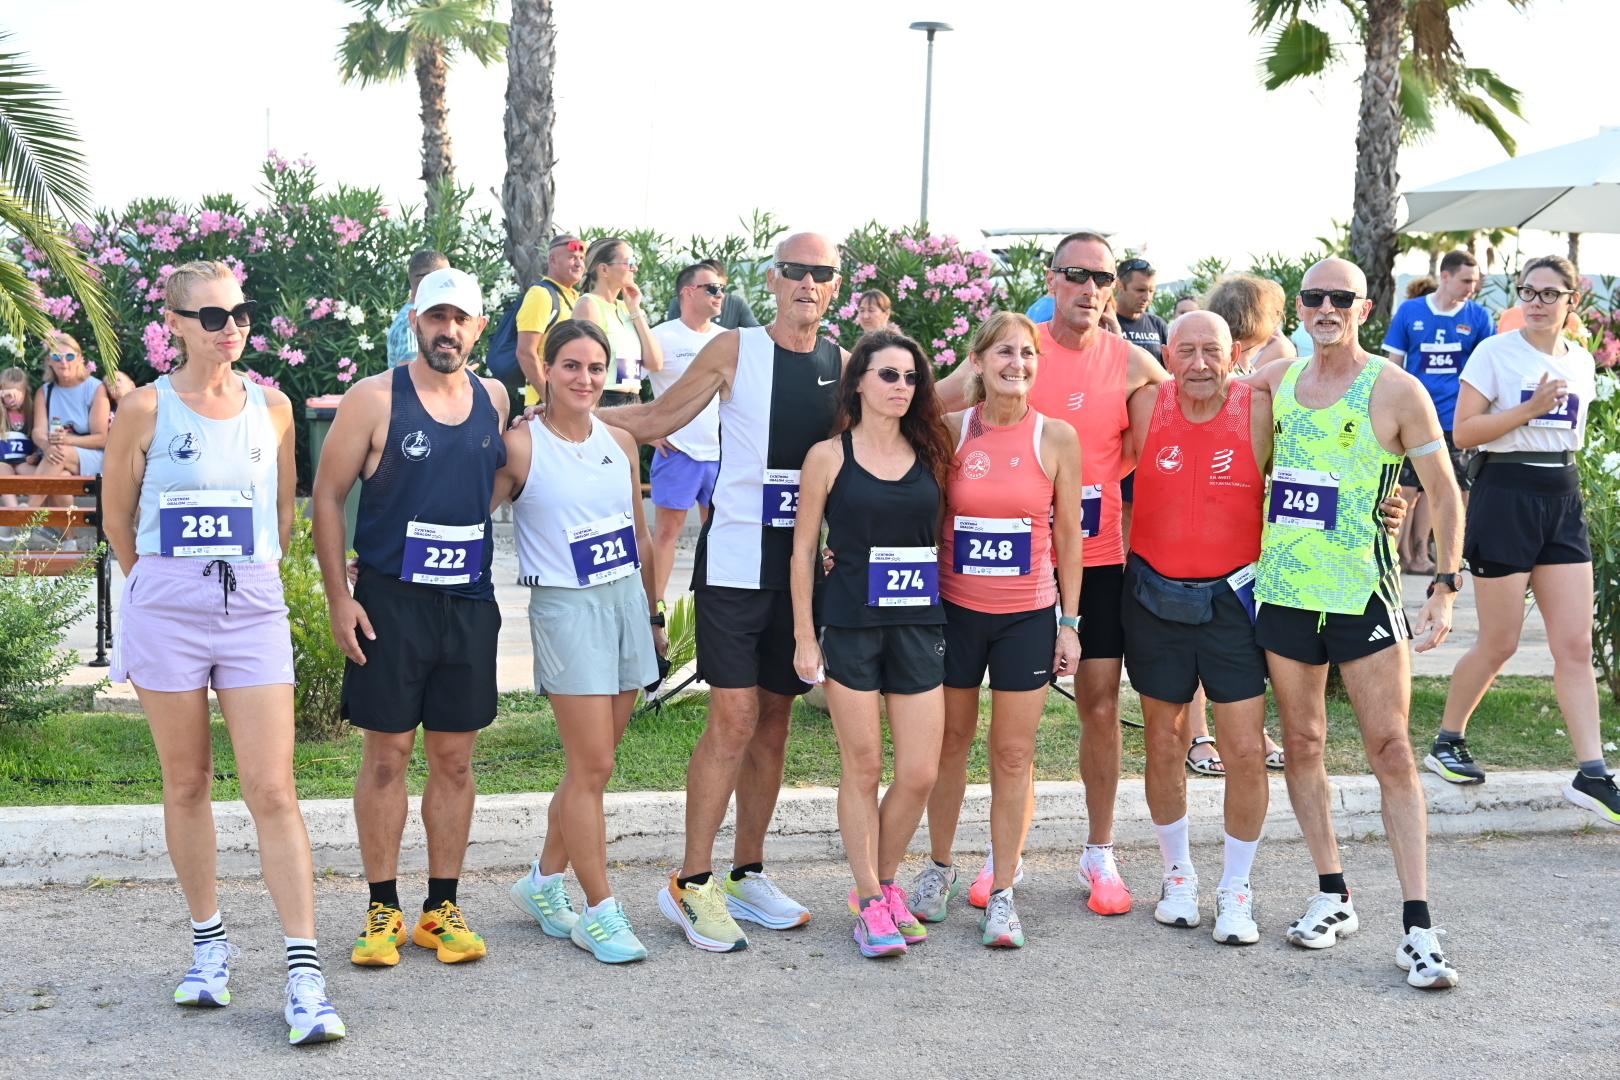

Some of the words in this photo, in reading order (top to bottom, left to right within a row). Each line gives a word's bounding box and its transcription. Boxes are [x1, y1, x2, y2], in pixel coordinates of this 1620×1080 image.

[1434, 329, 1446, 344] 5
[1428, 354, 1454, 367] 264
[10, 440, 24, 452] 72
[1282, 489, 1320, 513] 249
[181, 514, 233, 539] 281
[423, 546, 467, 569] 222
[589, 536, 628, 566] 221
[968, 538, 1013, 561] 248
[886, 569, 924, 591] 274
[680, 898, 698, 925] HOKA
